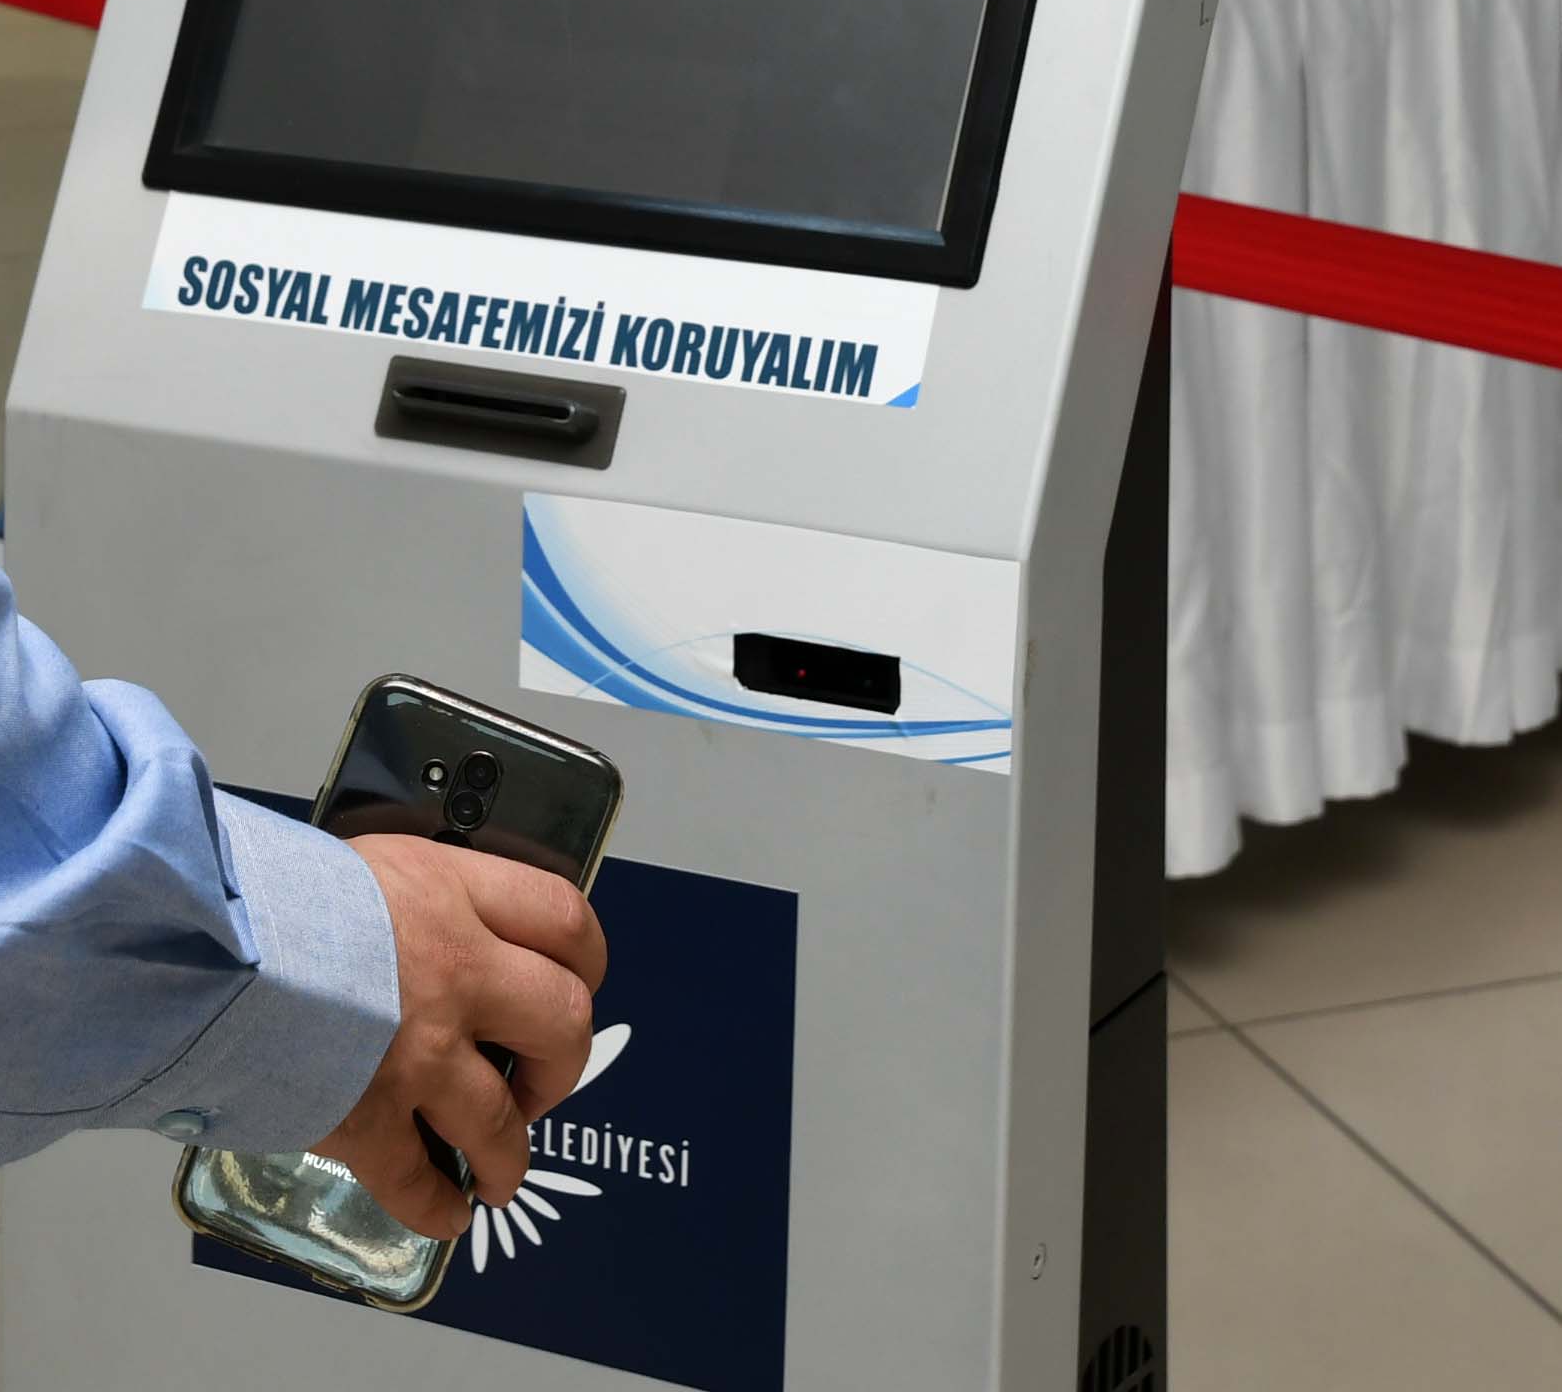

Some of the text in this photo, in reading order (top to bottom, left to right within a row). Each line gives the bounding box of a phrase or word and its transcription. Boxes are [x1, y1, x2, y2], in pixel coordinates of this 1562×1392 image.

[177, 255, 879, 398] SOSYAL MESAFEMİZİ KORUYALIM
[526, 1118, 690, 1188] ELEDİYESİ
